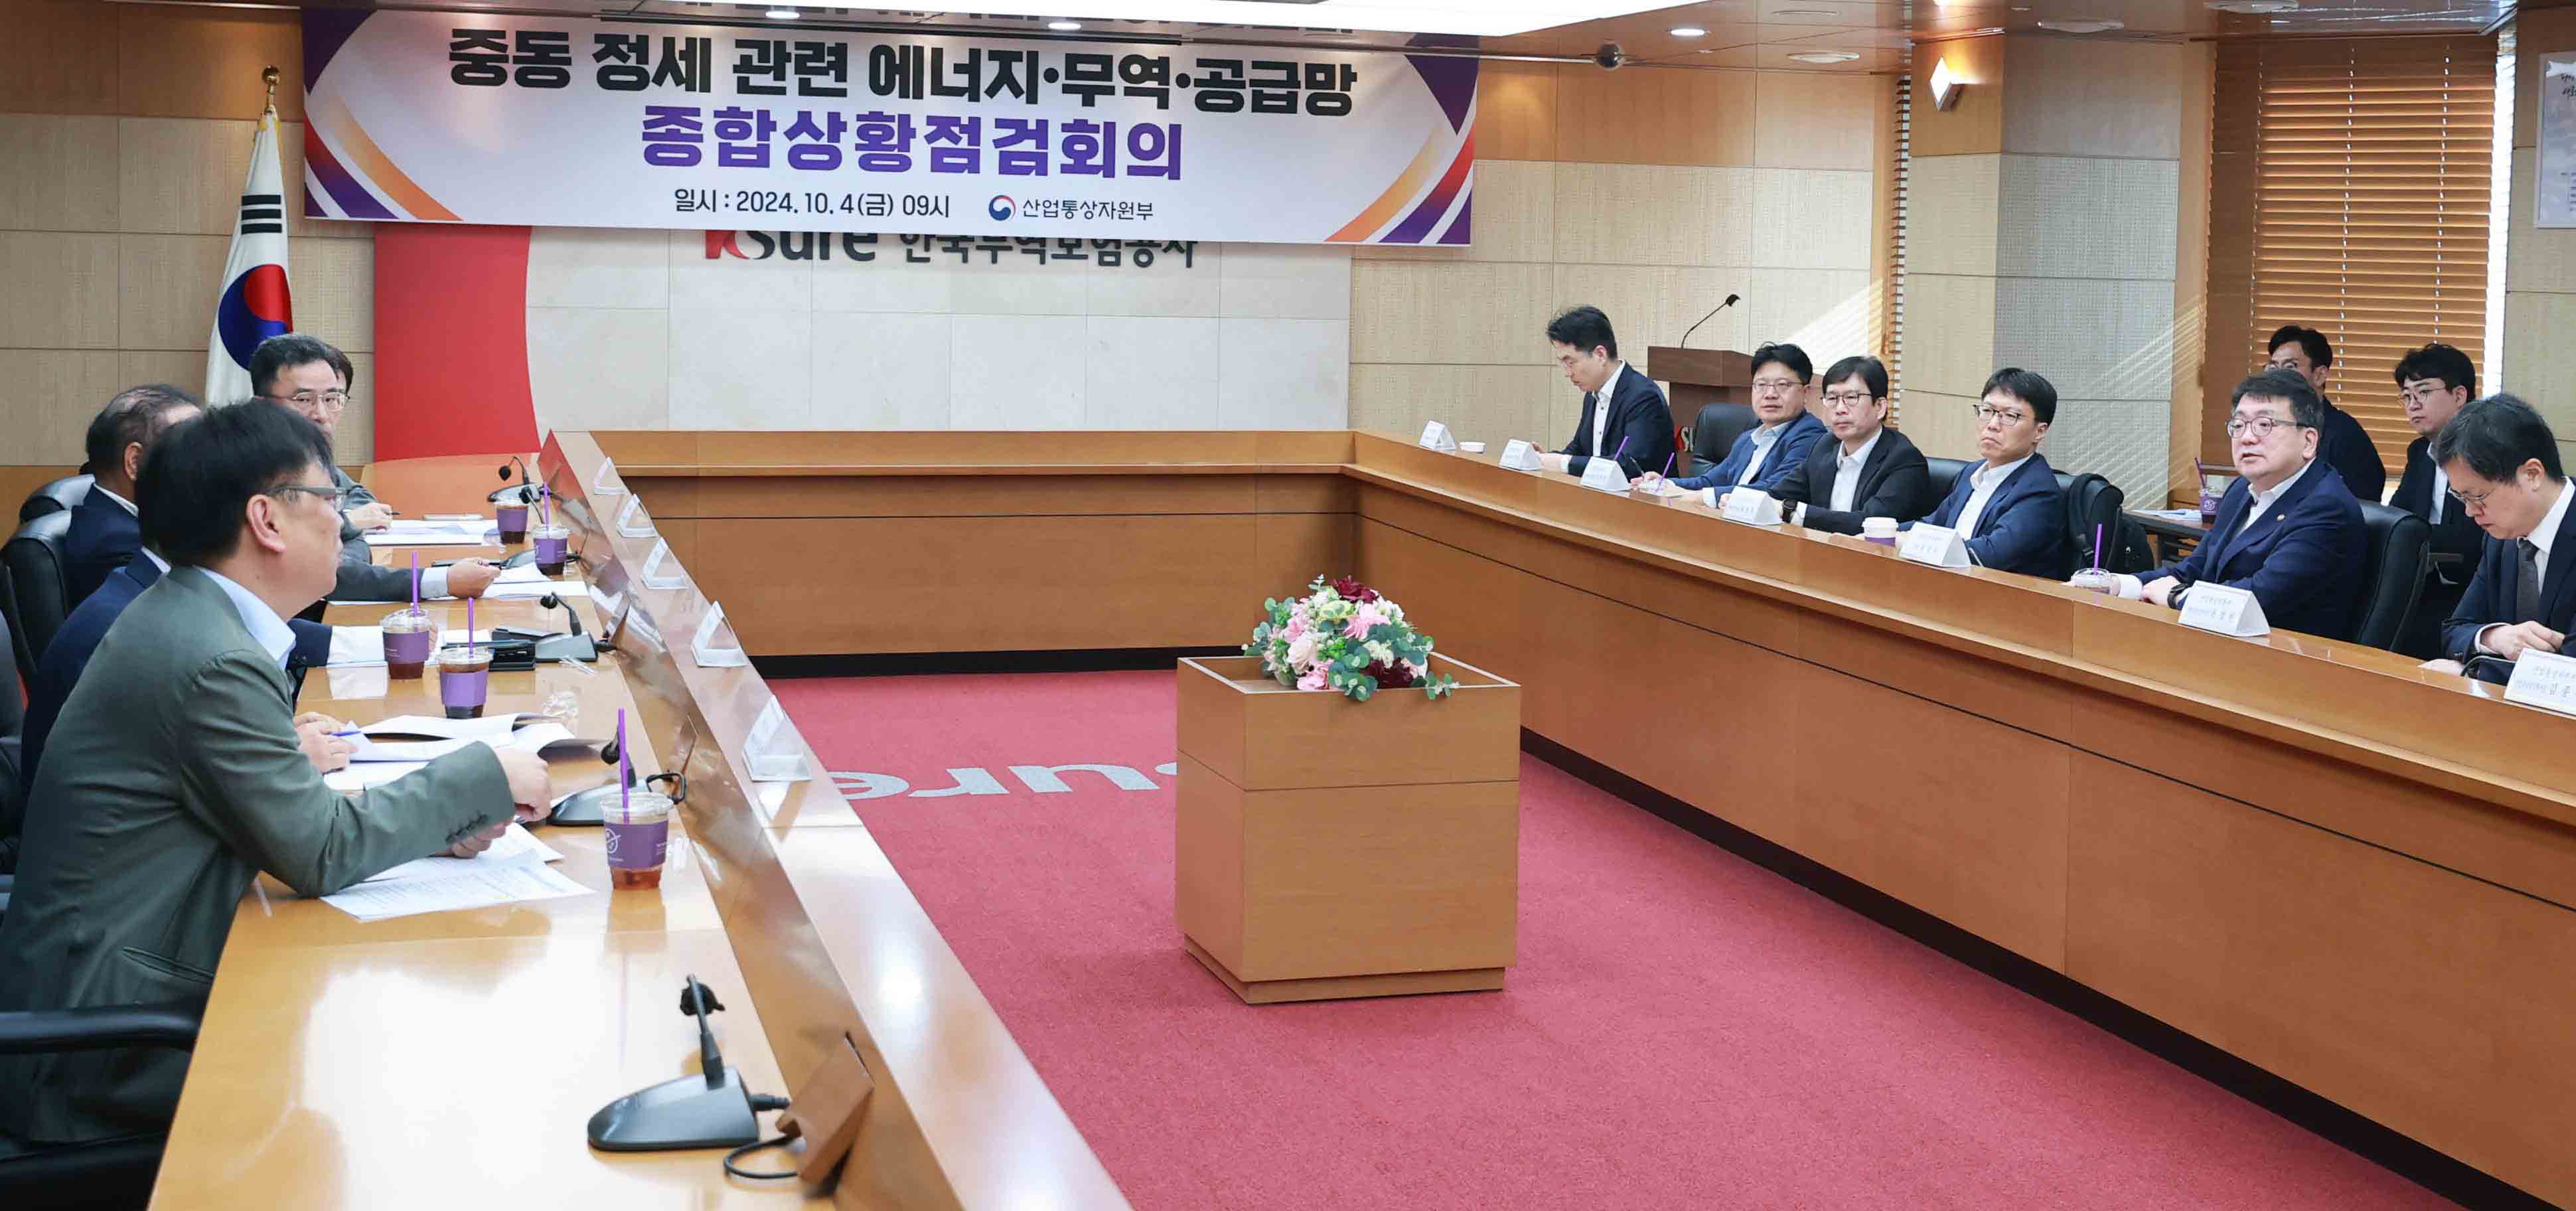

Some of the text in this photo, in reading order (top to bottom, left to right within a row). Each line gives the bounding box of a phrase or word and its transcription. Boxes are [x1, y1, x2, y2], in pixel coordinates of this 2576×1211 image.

[449, 28, 572, 89] 중동
[591, 35, 712, 93] 정세
[732, 39, 848, 98] 관련
[641, 105, 1182, 181] 종합상황점검회의
[737, 191, 798, 214] 2024.
[804, 193, 834, 214] 10.
[840, 193, 894, 216] 4(금)
[902, 195, 949, 218] 09시
[1023, 199, 1154, 221] 산업통상자원부
